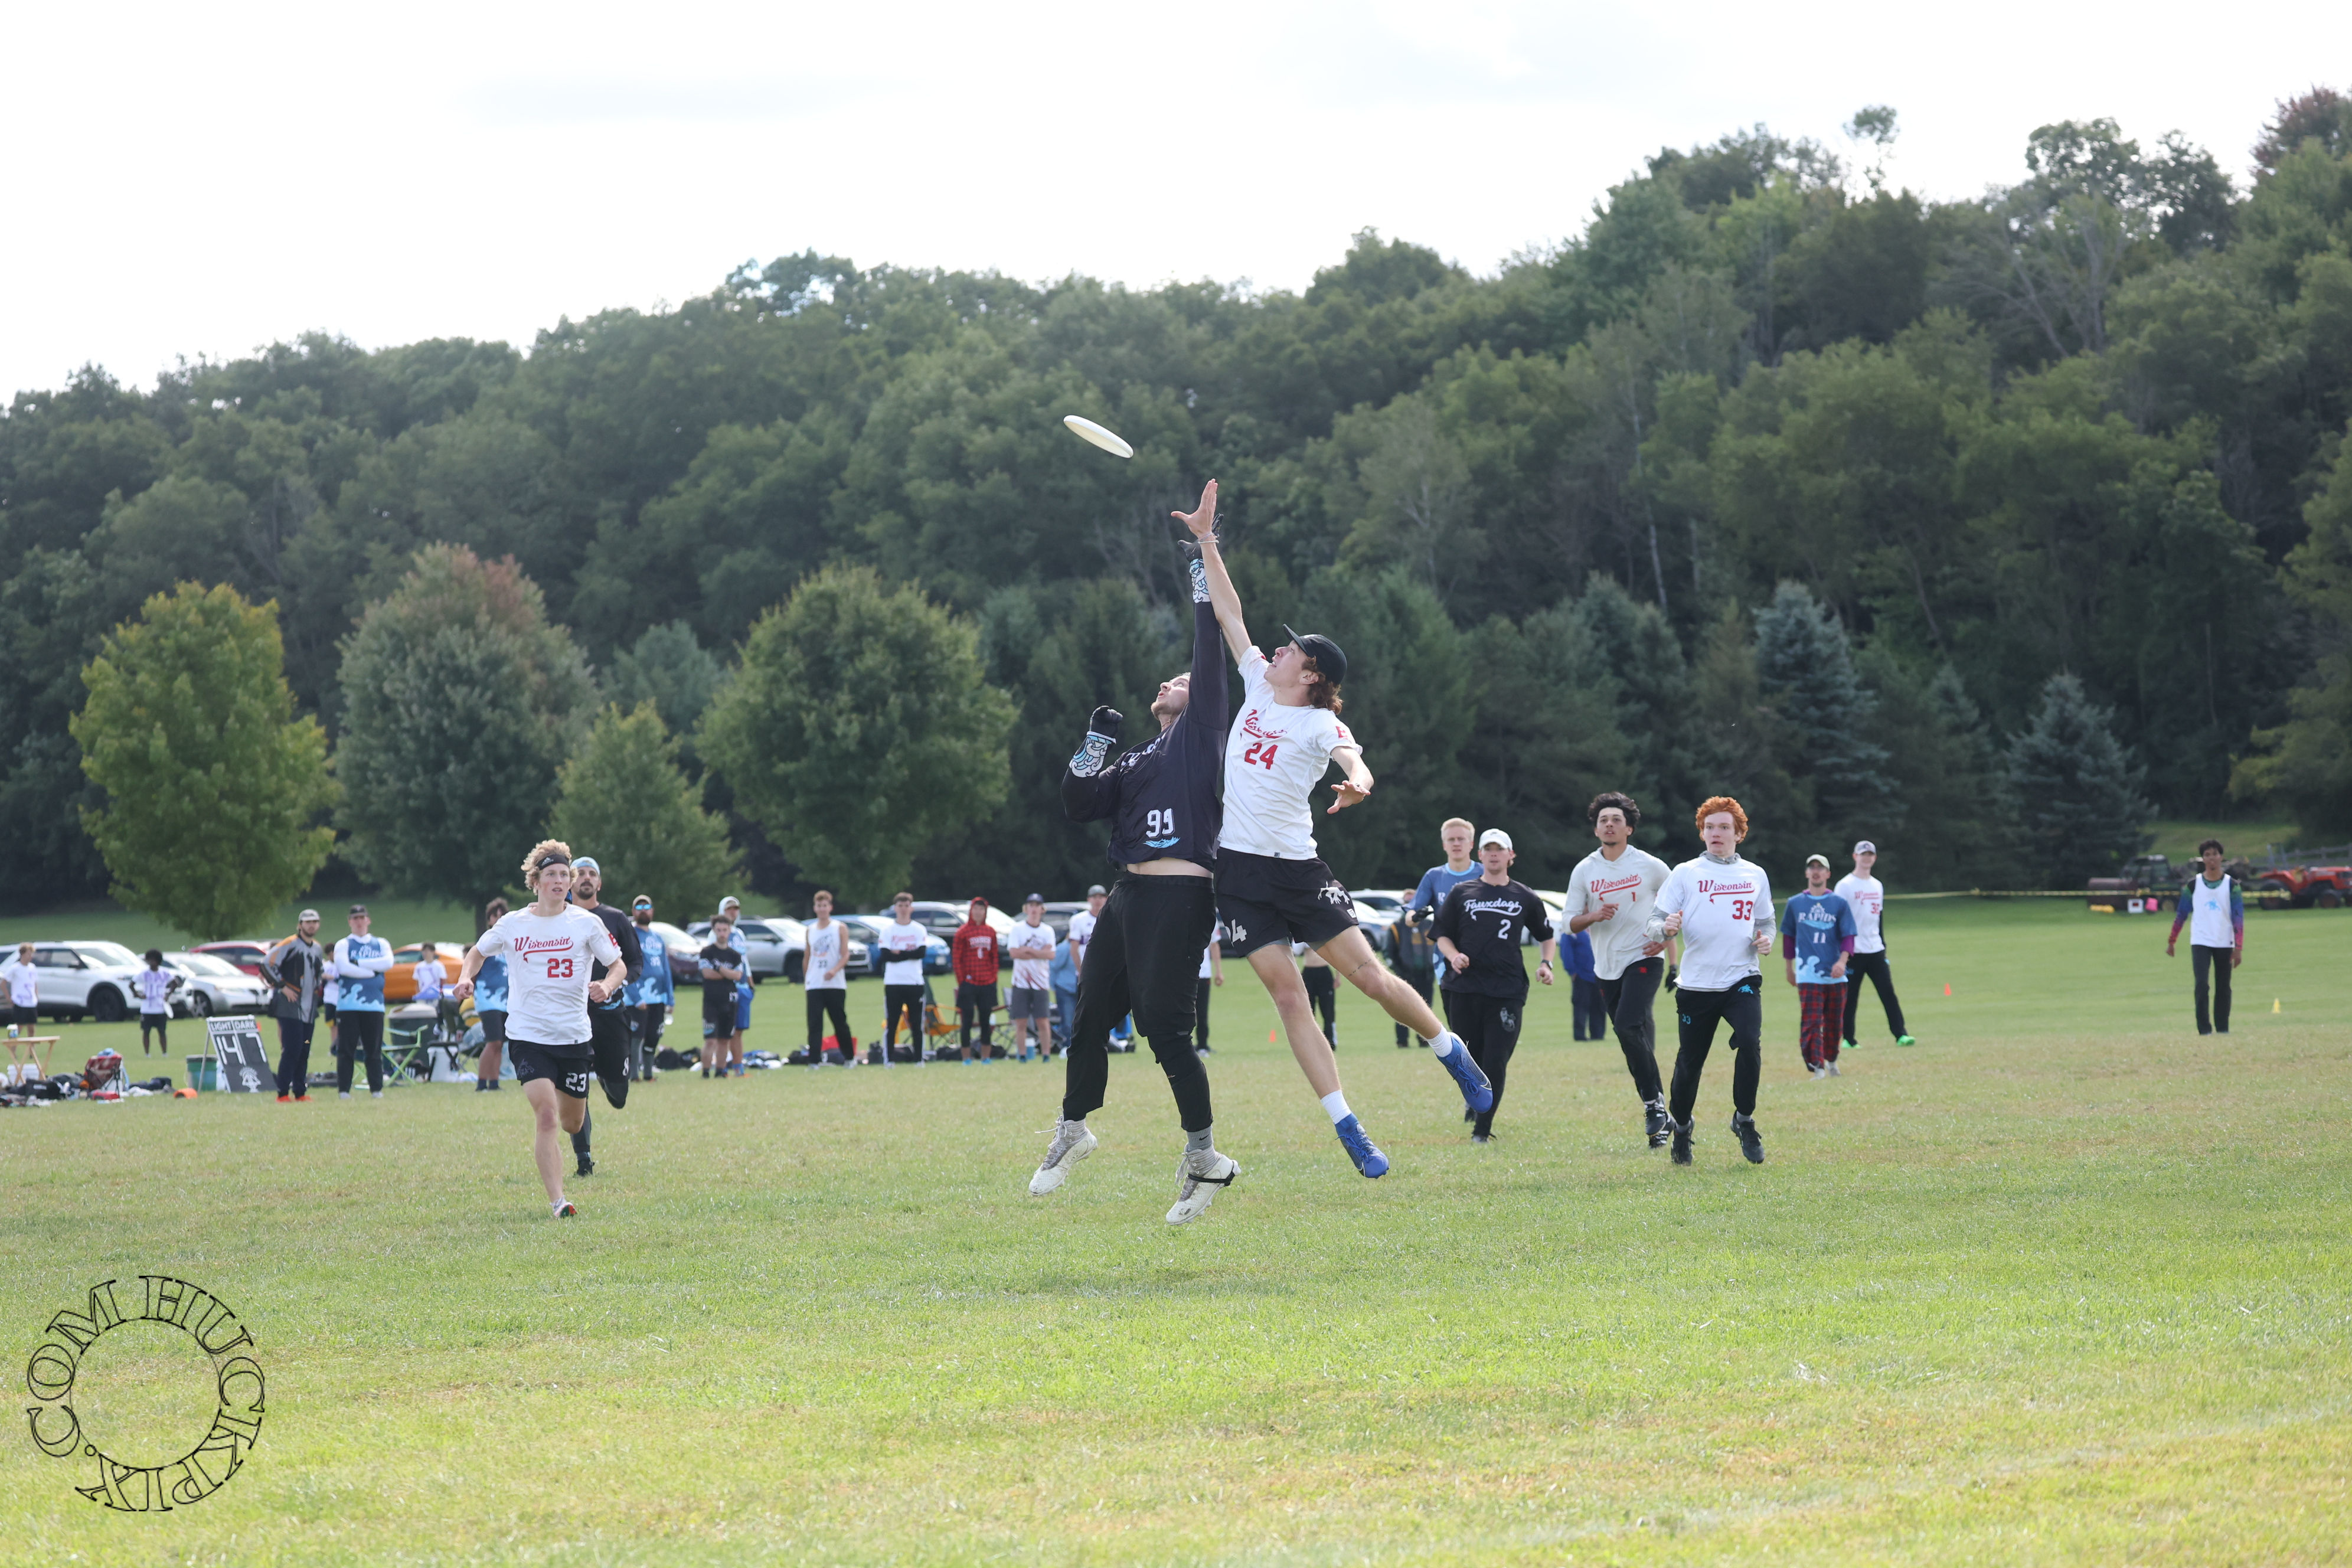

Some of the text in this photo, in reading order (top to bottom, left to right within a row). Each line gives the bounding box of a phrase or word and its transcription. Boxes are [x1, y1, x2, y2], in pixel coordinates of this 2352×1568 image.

[1244, 742, 1278, 770] 24
[1146, 808, 1175, 838] 99
[1590, 874, 1639, 893] Wisconsin
[1697, 880, 1752, 893] Wisconsin
[1631, 891, 1636, 902] 1
[1732, 900, 1753, 920] 33
[1798, 912, 1837, 922] RAPIDS
[1225, 919, 1247, 944] 4
[1498, 919, 1511, 940] 2
[514, 936, 570, 952] Wisconsin
[547, 958, 573, 978] 23
[210, 1020, 256, 1031] LIGHT DARK
[216, 1032, 267, 1065] 14 7
[622, 1057, 630, 1076] 8
[565, 1072, 587, 1092] 23
